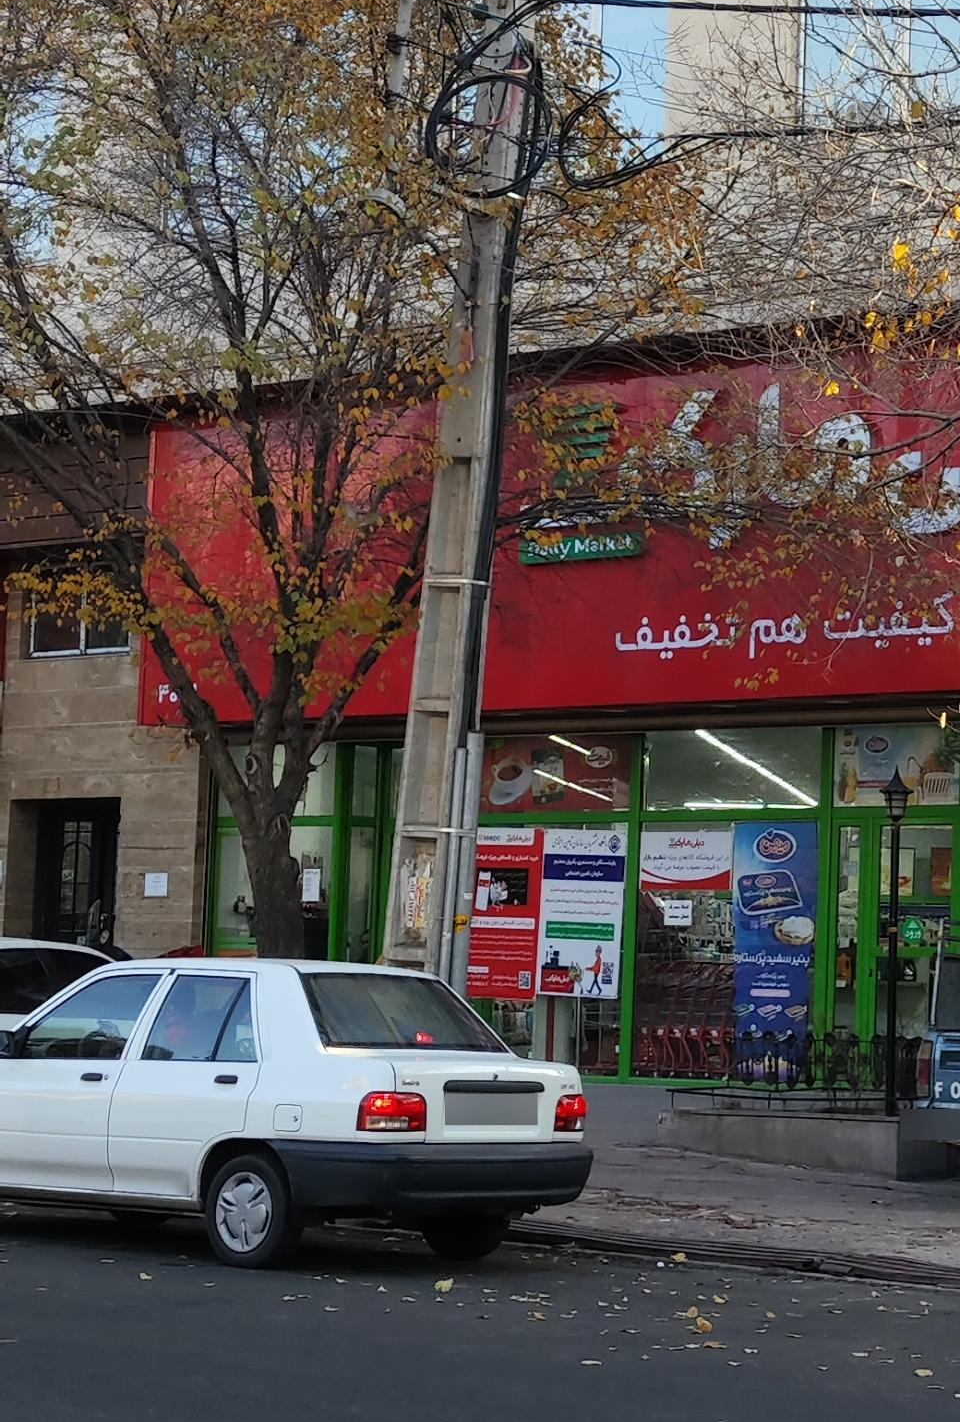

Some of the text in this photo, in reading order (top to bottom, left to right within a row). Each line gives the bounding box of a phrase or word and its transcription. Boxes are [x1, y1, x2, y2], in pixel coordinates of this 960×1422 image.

[574, 534, 635, 554] Market
[823, 590, 956, 648] کیفیت
[615, 611, 739, 660] تخفیف
[748, 613, 807, 659] هم
[904, 929, 921, 940] ورود
[766, 953, 791, 966] سفید
[790, 953, 810, 968] پنیر
